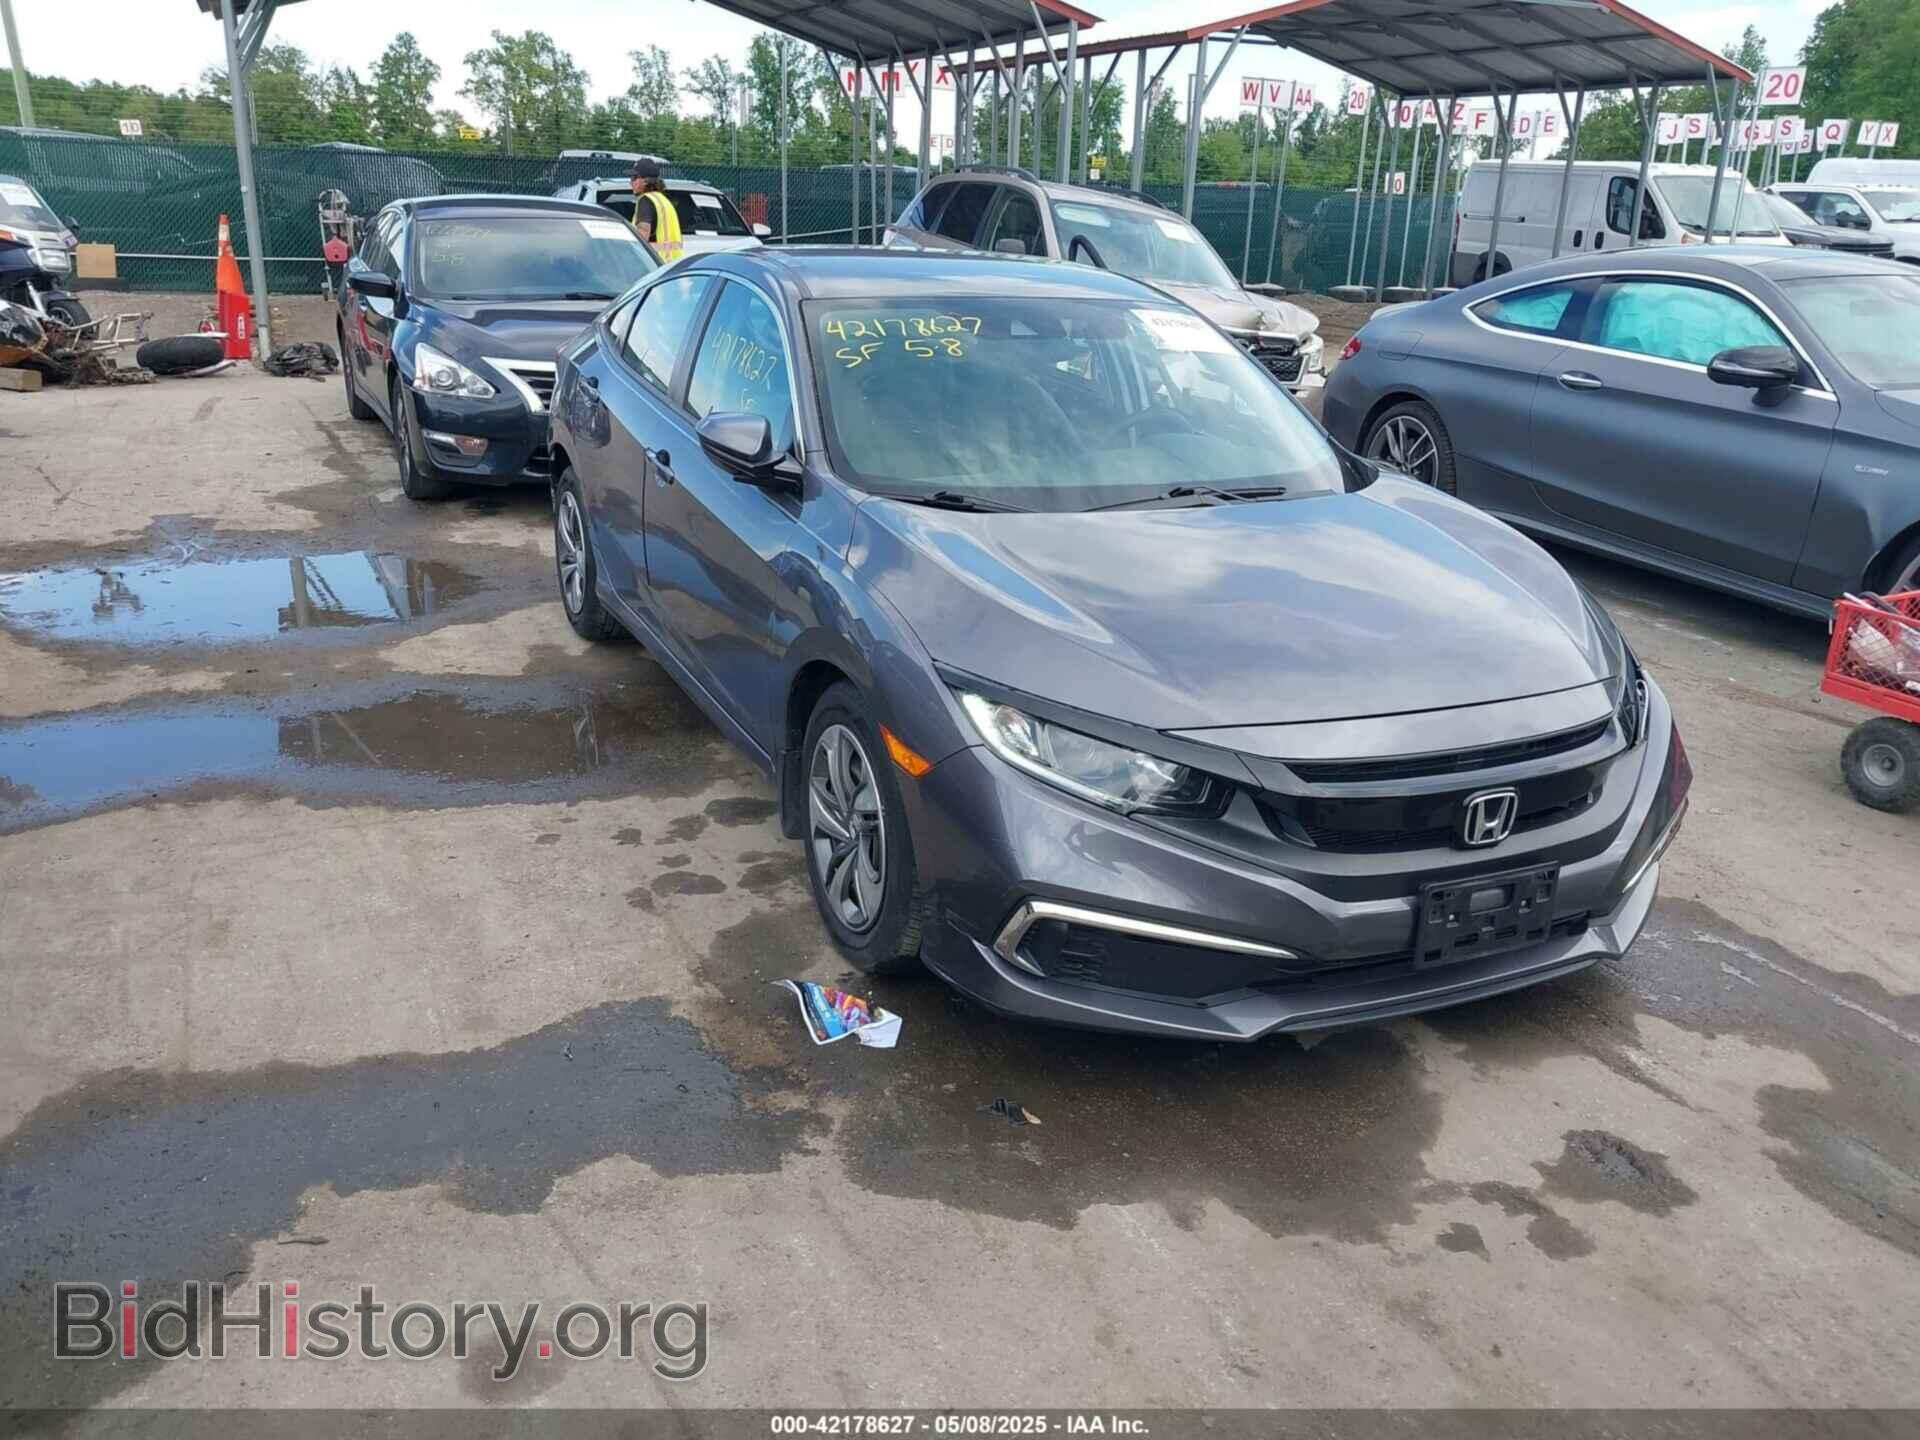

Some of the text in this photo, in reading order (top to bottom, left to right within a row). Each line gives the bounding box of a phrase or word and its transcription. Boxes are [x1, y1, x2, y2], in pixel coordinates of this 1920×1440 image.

[1243, 82, 1259, 101] W
[1270, 85, 1281, 103] V
[1765, 73, 1800, 98] 20
[1295, 88, 1312, 108] AA
[1350, 90, 1365, 109] 20
[1475, 112, 1488, 130] F
[1519, 117, 1531, 134] D
[1543, 115, 1556, 133] E
[1688, 118, 1701, 134] S
[1780, 119, 1793, 136] S
[1667, 123, 1678, 139] J
[1744, 125, 1760, 140] G
[1825, 124, 1841, 140] Q
[1883, 126, 1893, 142] X
[826, 315, 982, 341] 42178627
[835, 341, 885, 369] SF
